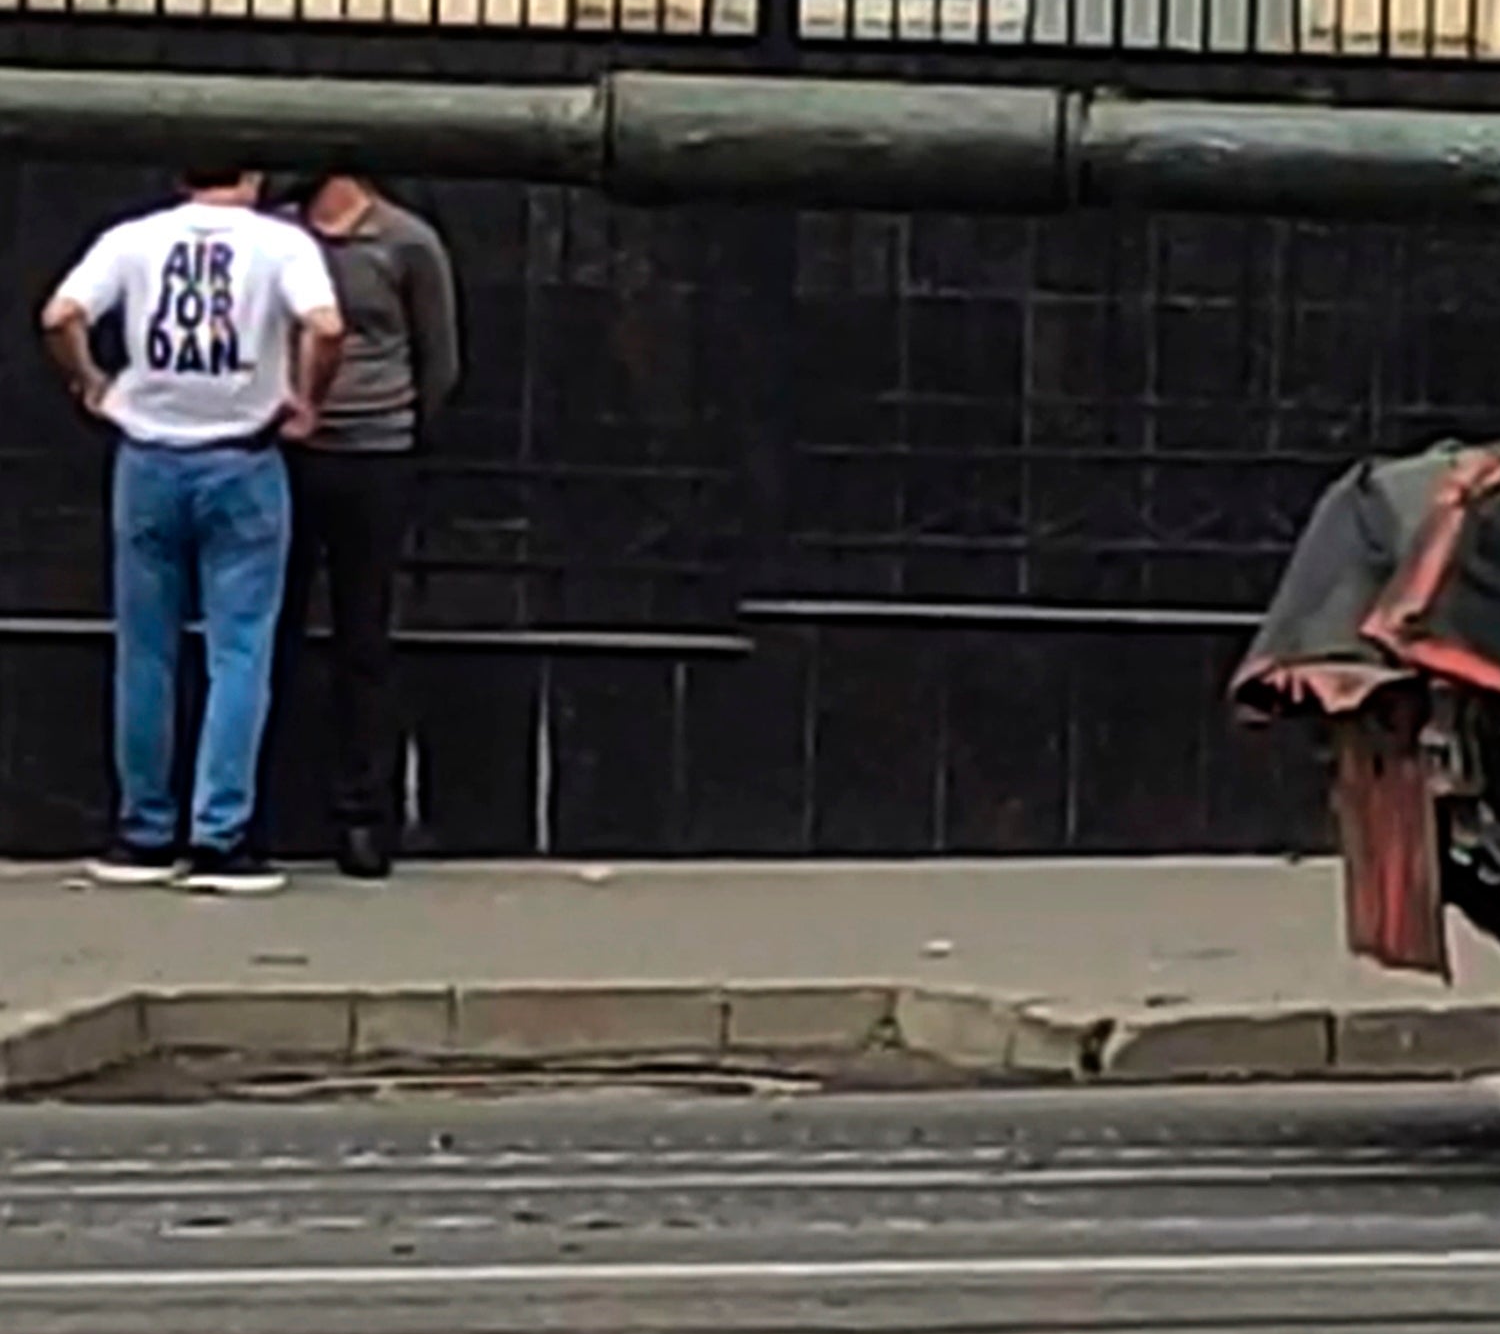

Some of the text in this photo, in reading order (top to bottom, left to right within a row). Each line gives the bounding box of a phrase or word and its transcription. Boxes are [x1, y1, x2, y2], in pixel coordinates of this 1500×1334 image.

[163, 242, 234, 287] AIR
[158, 283, 235, 327] JOR
[148, 321, 240, 374] DAN
